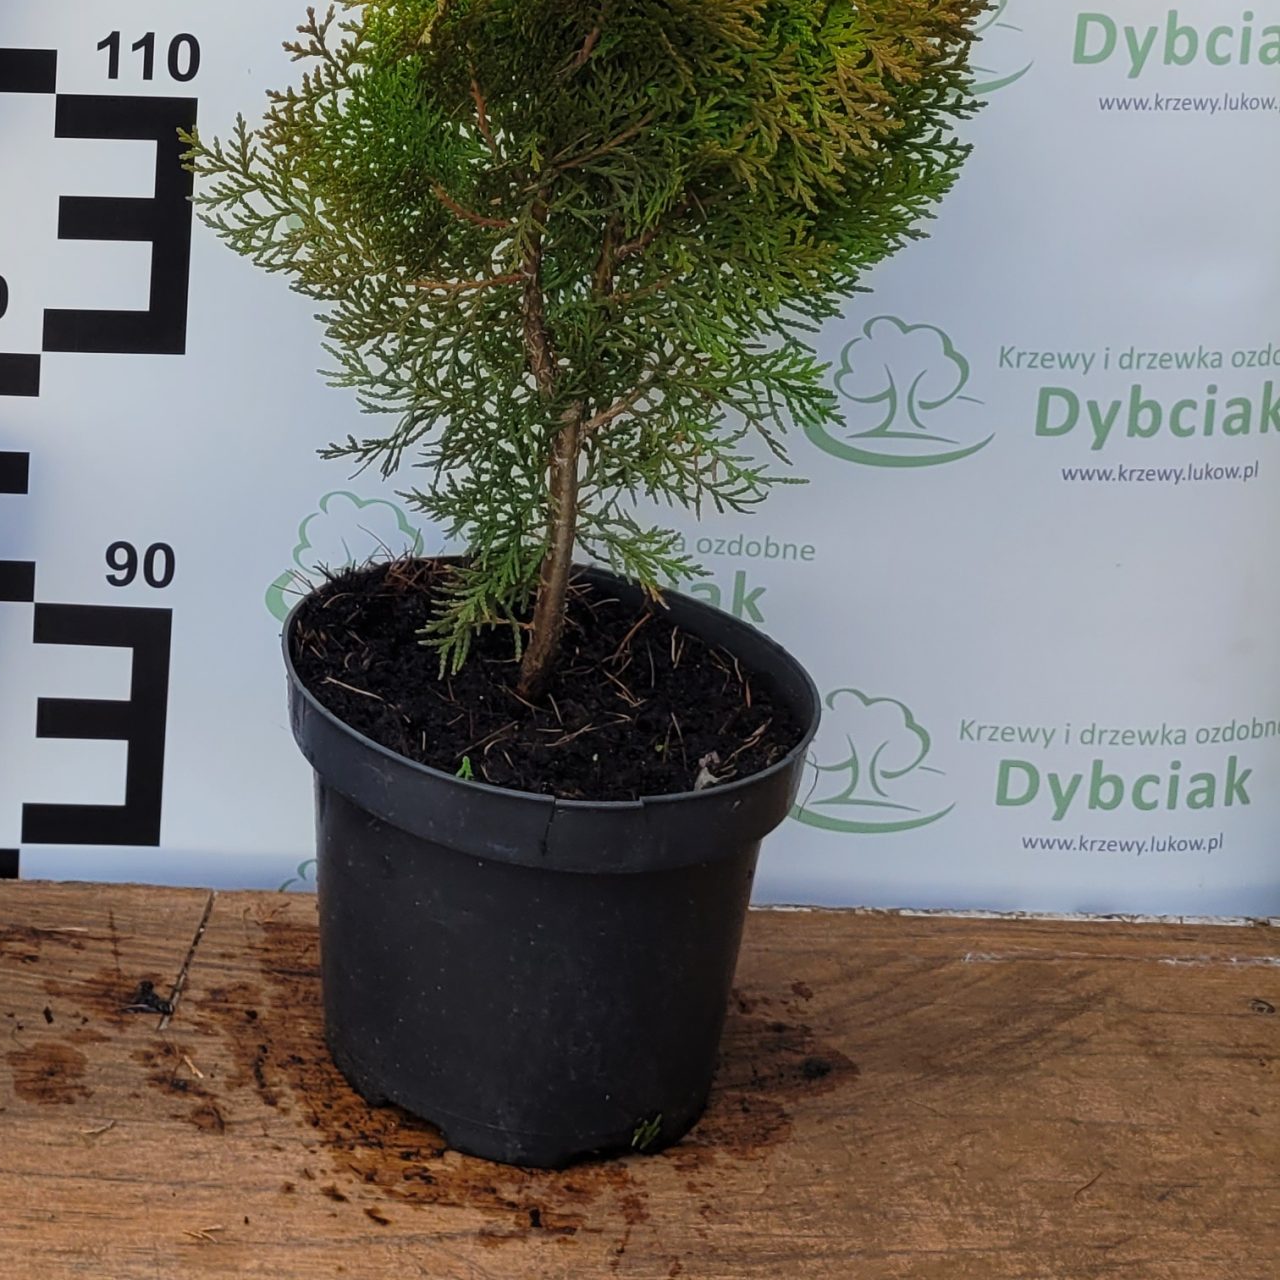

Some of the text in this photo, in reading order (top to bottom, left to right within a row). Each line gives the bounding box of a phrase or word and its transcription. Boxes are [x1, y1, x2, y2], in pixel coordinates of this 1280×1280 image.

[97, 31, 201, 82] 110
[1099, 93, 1280, 114] www.krzewy.lukow.
[999, 345, 1096, 375] Krzewy
[1103, 346, 1111, 370] i
[1119, 345, 1222, 369] drzewka
[1035, 381, 1280, 450] Dybciak
[1062, 460, 1258, 485] www.krzewy.lukow.pl
[697, 534, 816, 560] ozdobne
[104, 541, 176, 589] 90
[960, 719, 1056, 748] Krzewy
[1064, 722, 1072, 745] i
[1080, 723, 1186, 745] drzewka
[996, 756, 1252, 821] Dybciak
[1022, 833, 1223, 856] www.krzewy.lukow.pl
